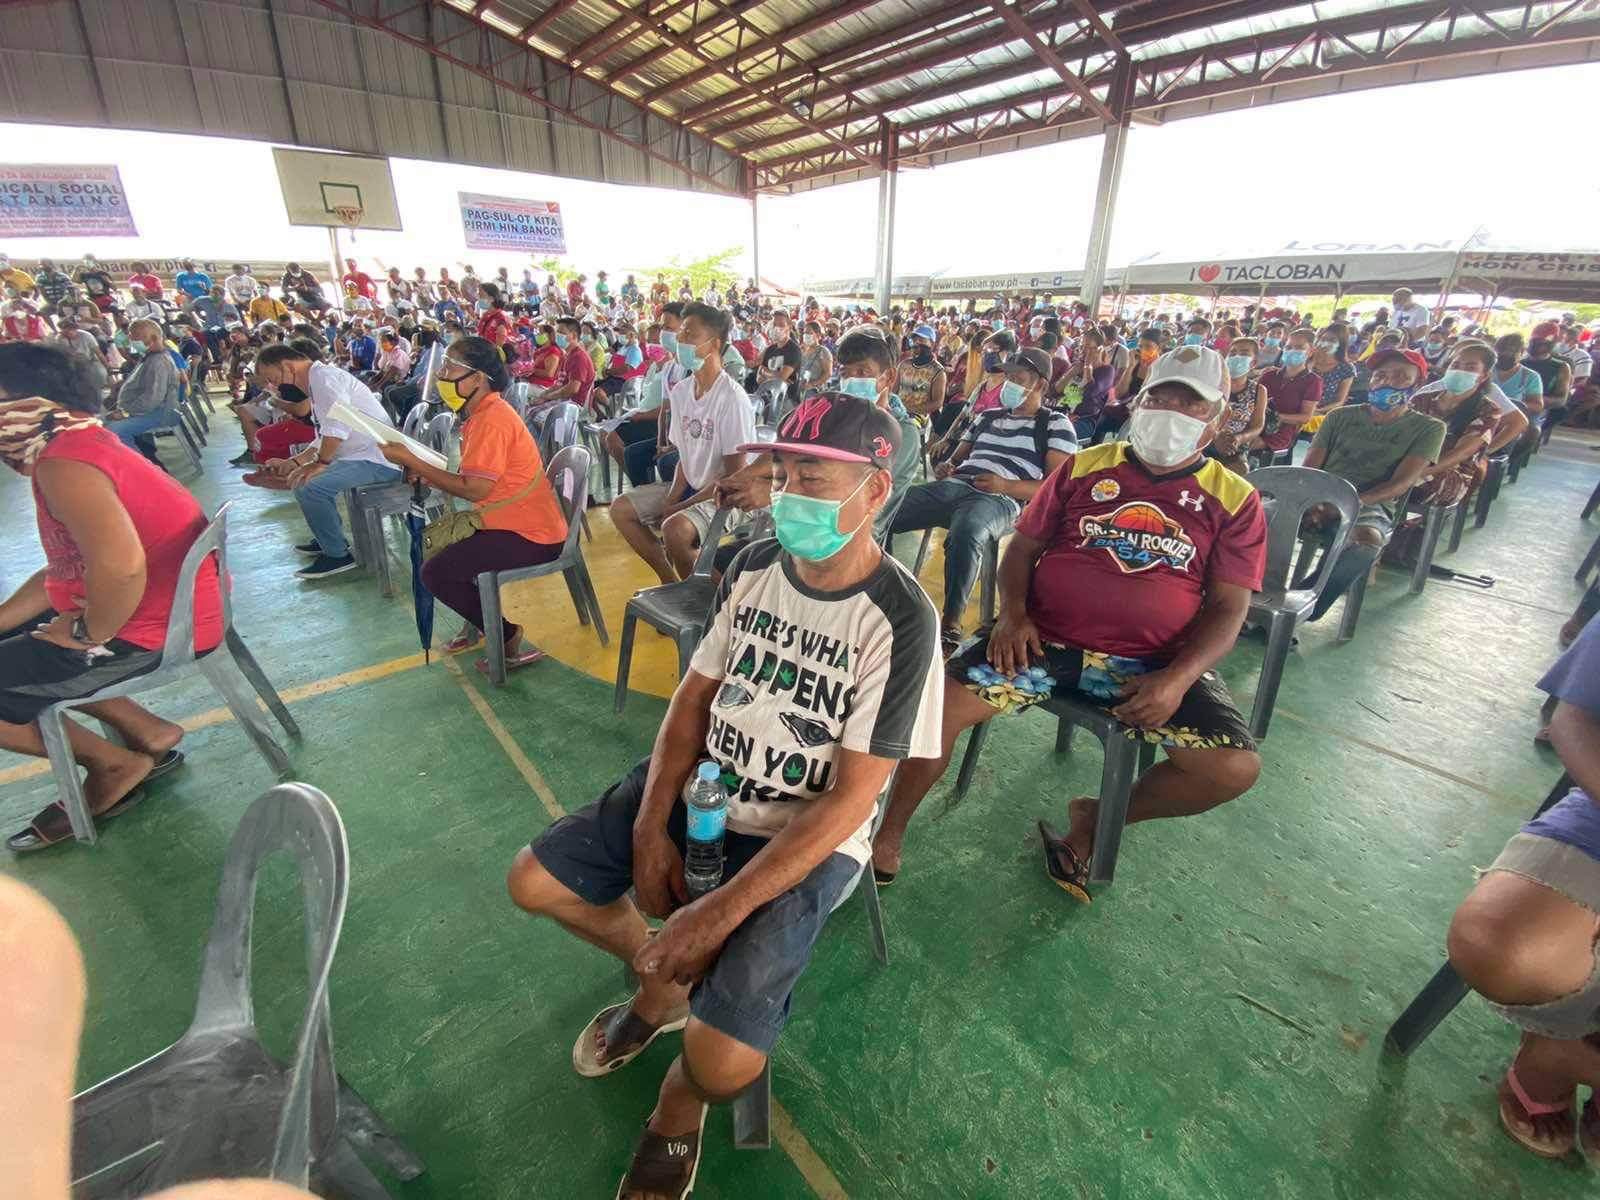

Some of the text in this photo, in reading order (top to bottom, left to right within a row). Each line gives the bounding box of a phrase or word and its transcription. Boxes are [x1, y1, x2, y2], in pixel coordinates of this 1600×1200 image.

[0, 183, 44, 193] ICAL
[58, 183, 122, 194] SOCIAL
[467, 208, 558, 226] PAG-SUL-OT KITA
[464, 220, 496, 231] PIRMI
[499, 222, 519, 233] HIN
[1190, 264, 1346, 281] I TACLOBAN
[1140, 534, 1192, 559] ROQUE
[764, 746, 832, 792] YOU
[667, 1141, 689, 1157] Vip
